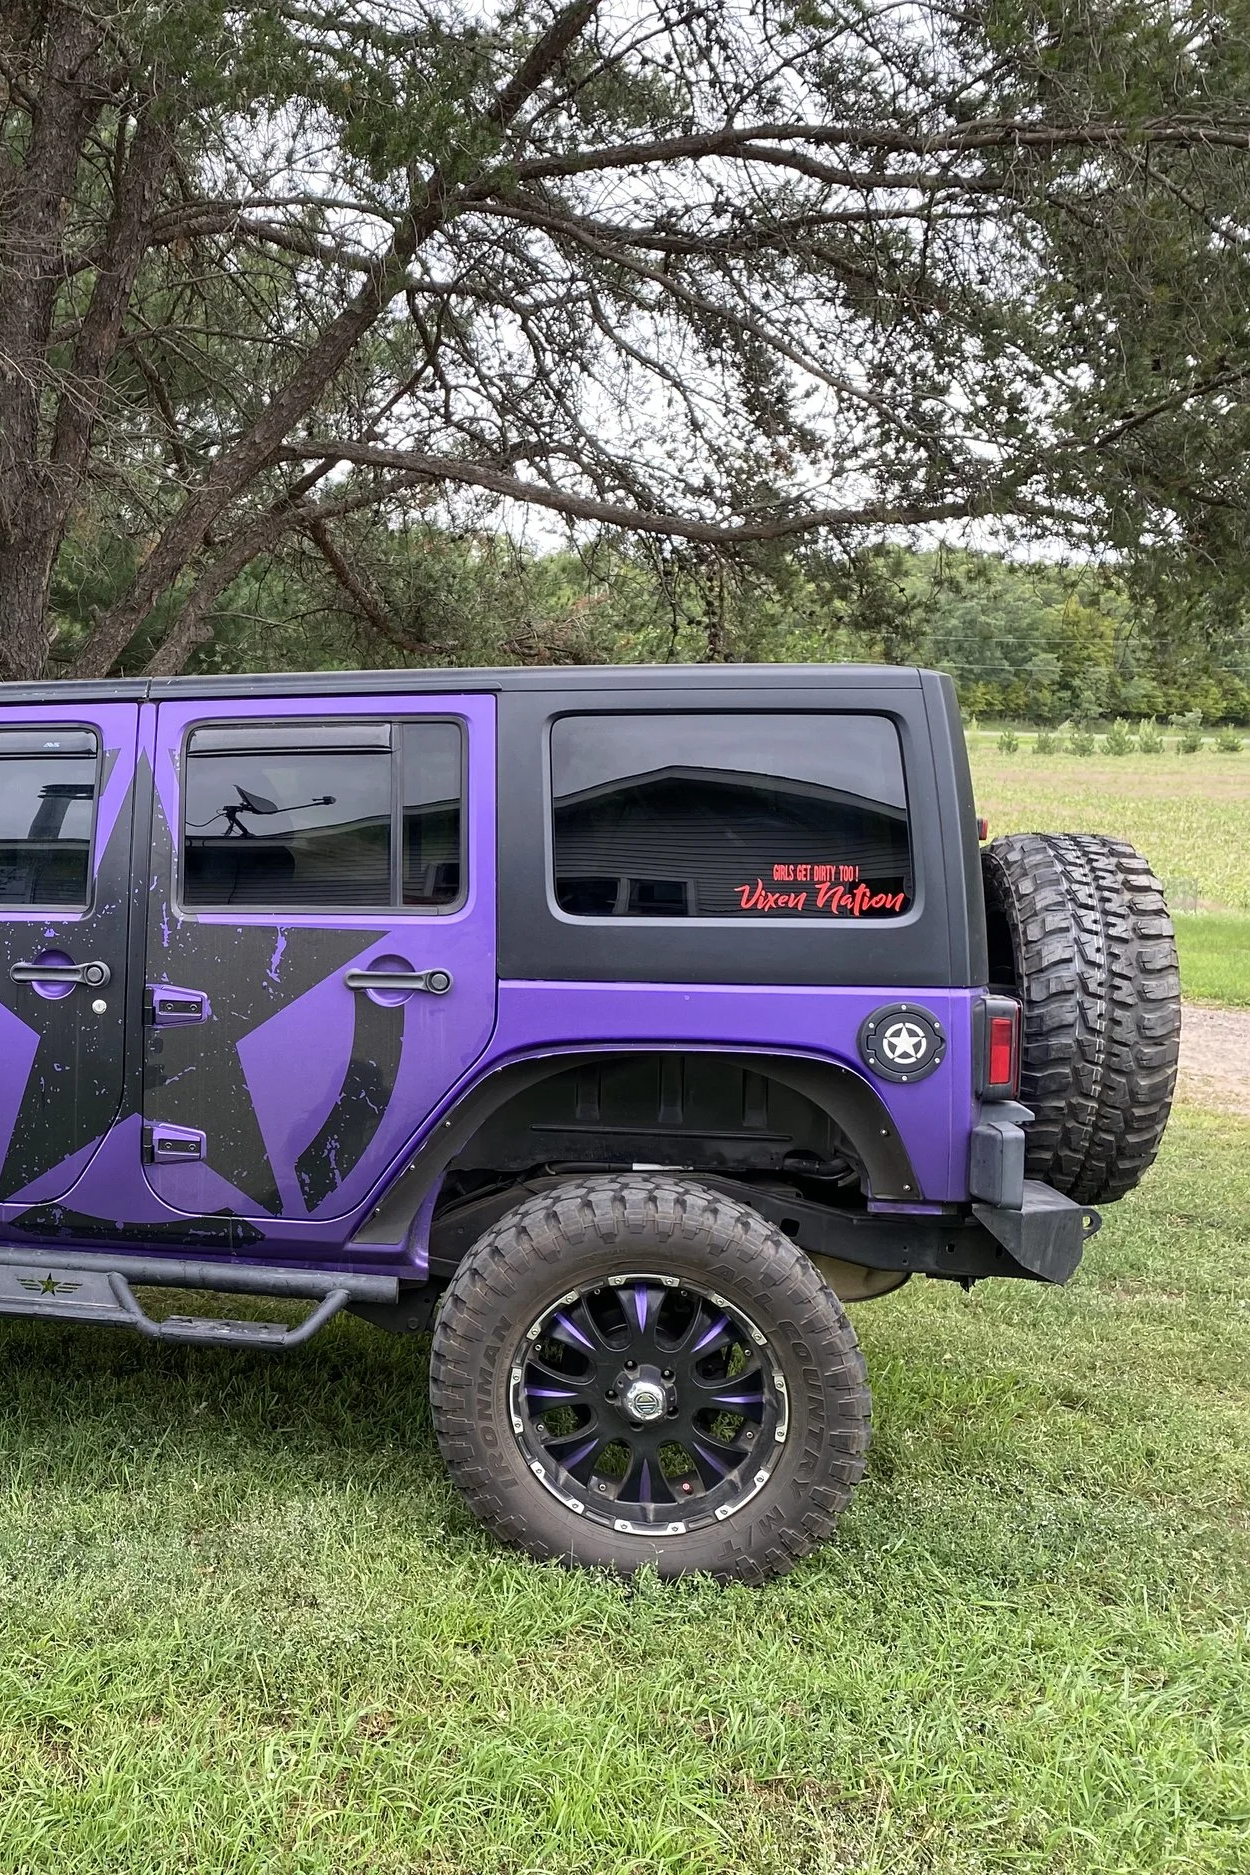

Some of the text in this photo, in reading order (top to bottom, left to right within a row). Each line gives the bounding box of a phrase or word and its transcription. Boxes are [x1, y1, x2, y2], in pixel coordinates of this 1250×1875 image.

[734, 878, 905, 916] Vixen Nation
[773, 864, 794, 881] GIRLS
[797, 865, 811, 881] GET
[814, 865, 836, 881] DIRTY
[477, 1314, 519, 1489] IRONMAN
[705, 1264, 826, 1561] ALL COUNTRY M/T
